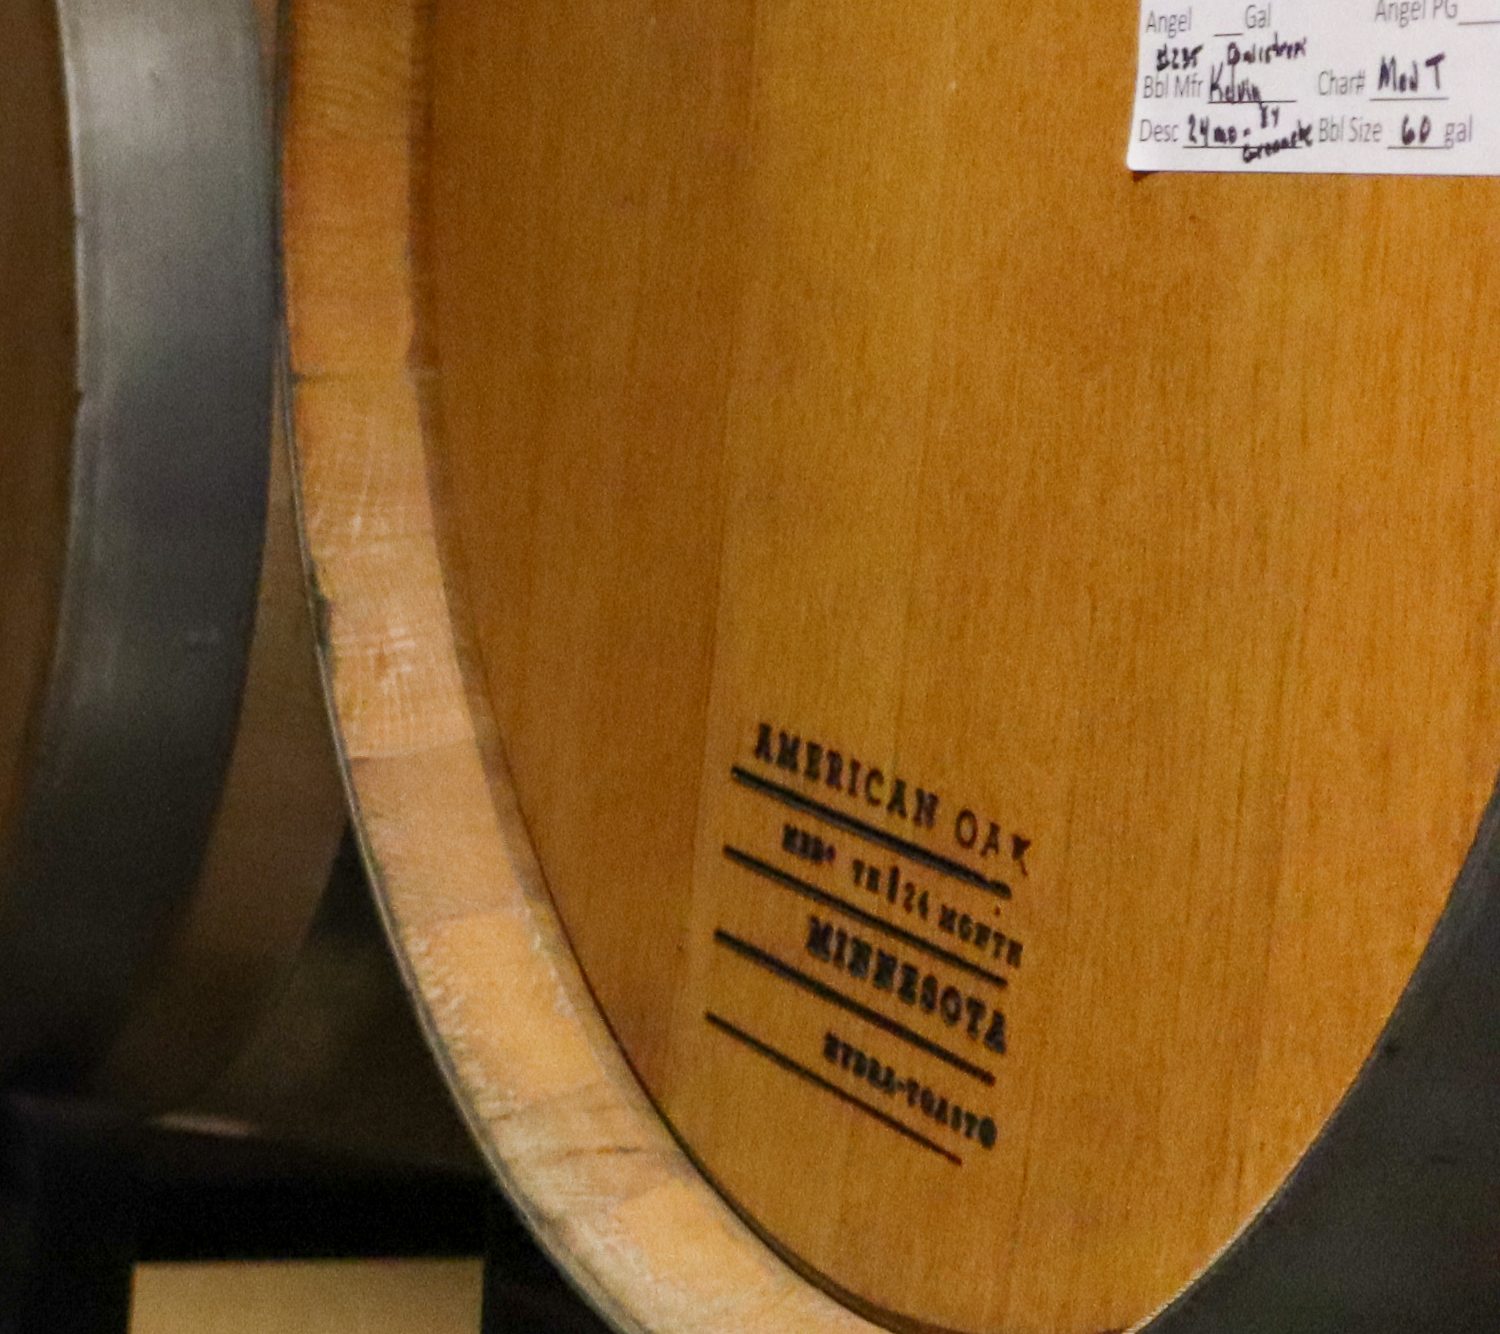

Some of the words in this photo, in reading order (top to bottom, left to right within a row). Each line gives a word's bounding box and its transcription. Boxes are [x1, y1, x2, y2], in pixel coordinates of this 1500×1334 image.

[1146, 7, 1192, 39] Angel
[1244, 3, 1272, 29] Gal
[1143, 74, 1169, 99] Bbl
[1174, 72, 1204, 98] Mfr
[1317, 70, 1365, 96] Char#
[1139, 119, 1180, 142] Desc
[1319, 115, 1343, 142] Bbl
[1349, 116, 1382, 142] Size
[1401, 114, 1431, 145] 60
[1444, 114, 1473, 149] gal
[753, 722, 939, 829] AMERICAN
[954, 807, 1035, 875] OAK
[806, 914, 1007, 1055] MINNESOTA
